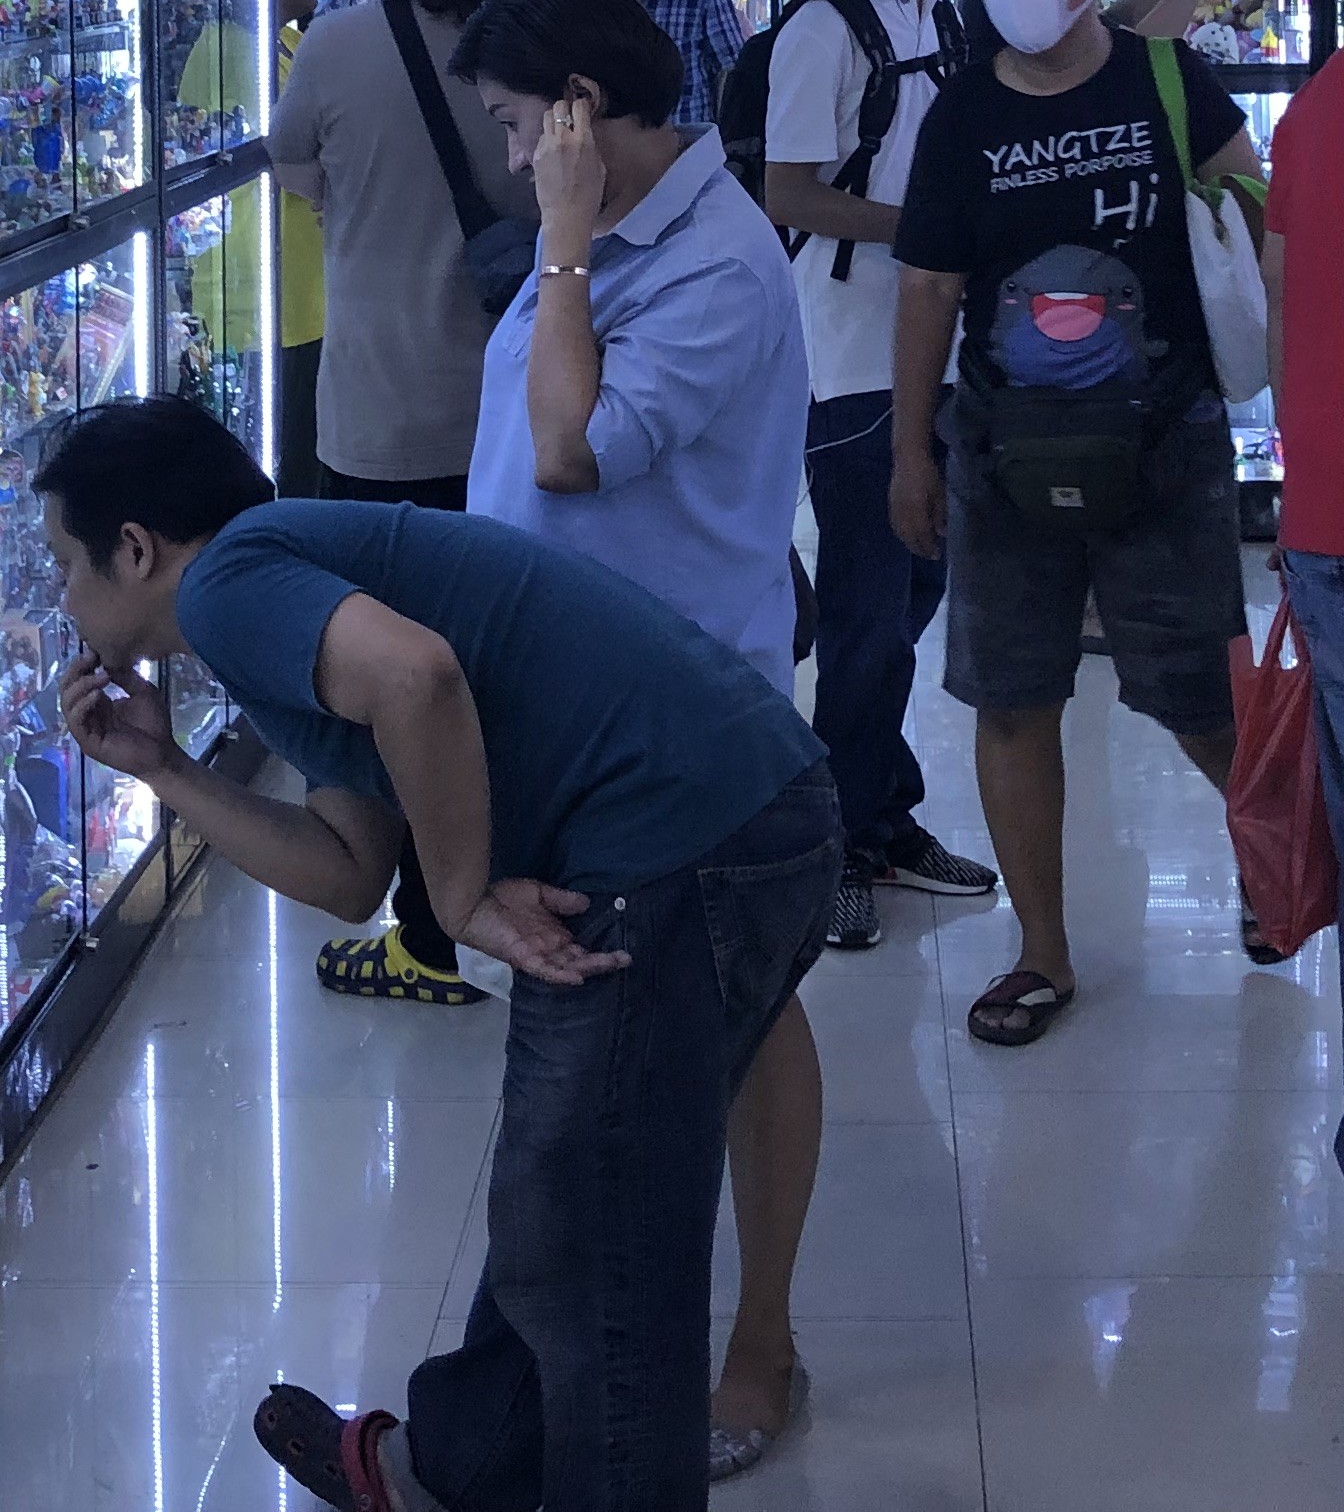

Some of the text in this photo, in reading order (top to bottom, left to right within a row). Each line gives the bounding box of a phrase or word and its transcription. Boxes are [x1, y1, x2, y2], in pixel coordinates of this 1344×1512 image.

[982, 121, 1153, 173] YANGTZE
[990, 150, 1153, 193] FINLESS PORPOISE
[1091, 172, 1159, 230] Hi
